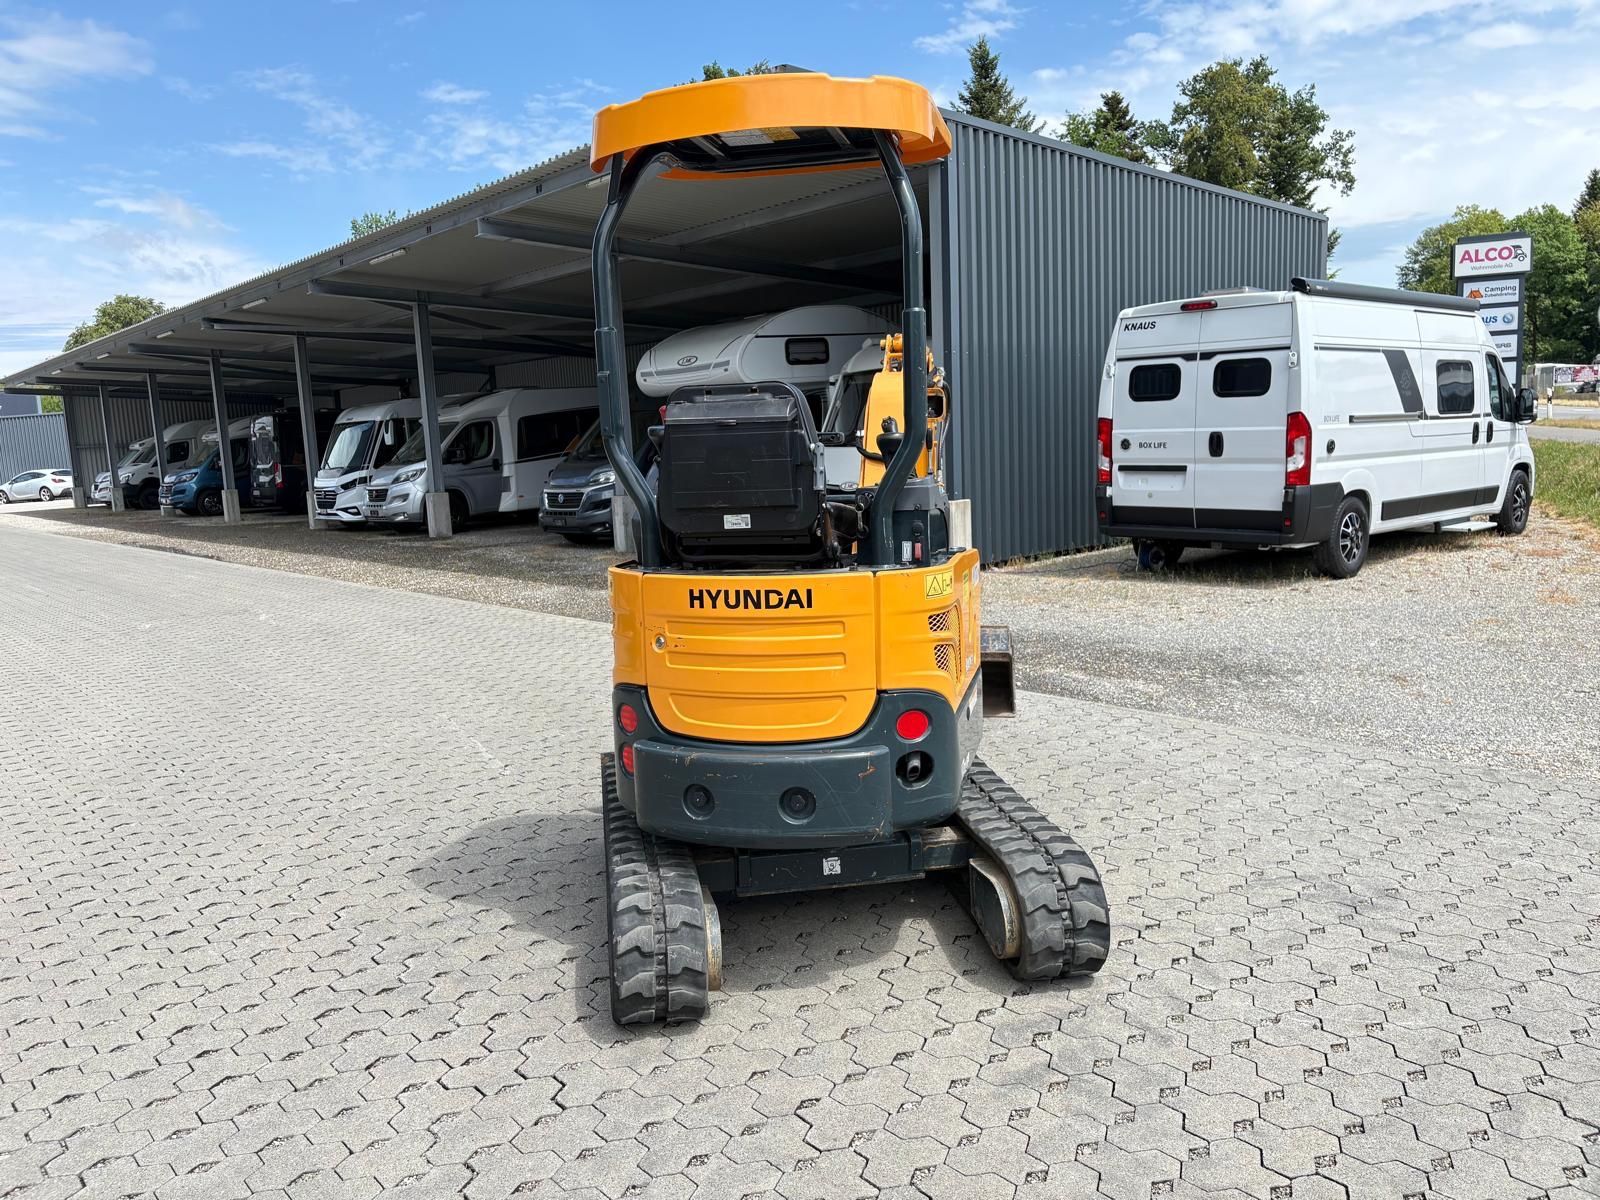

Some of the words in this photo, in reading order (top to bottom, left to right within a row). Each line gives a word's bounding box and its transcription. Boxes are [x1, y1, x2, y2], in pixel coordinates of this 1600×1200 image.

[1459, 246, 1513, 264] ALCO
[1484, 285, 1517, 293] Camping
[1124, 321, 1156, 331] KNAUS
[1138, 441, 1152, 449] BOX
[1153, 441, 1167, 449] LIFE
[689, 588, 813, 609] HYUNDAI
